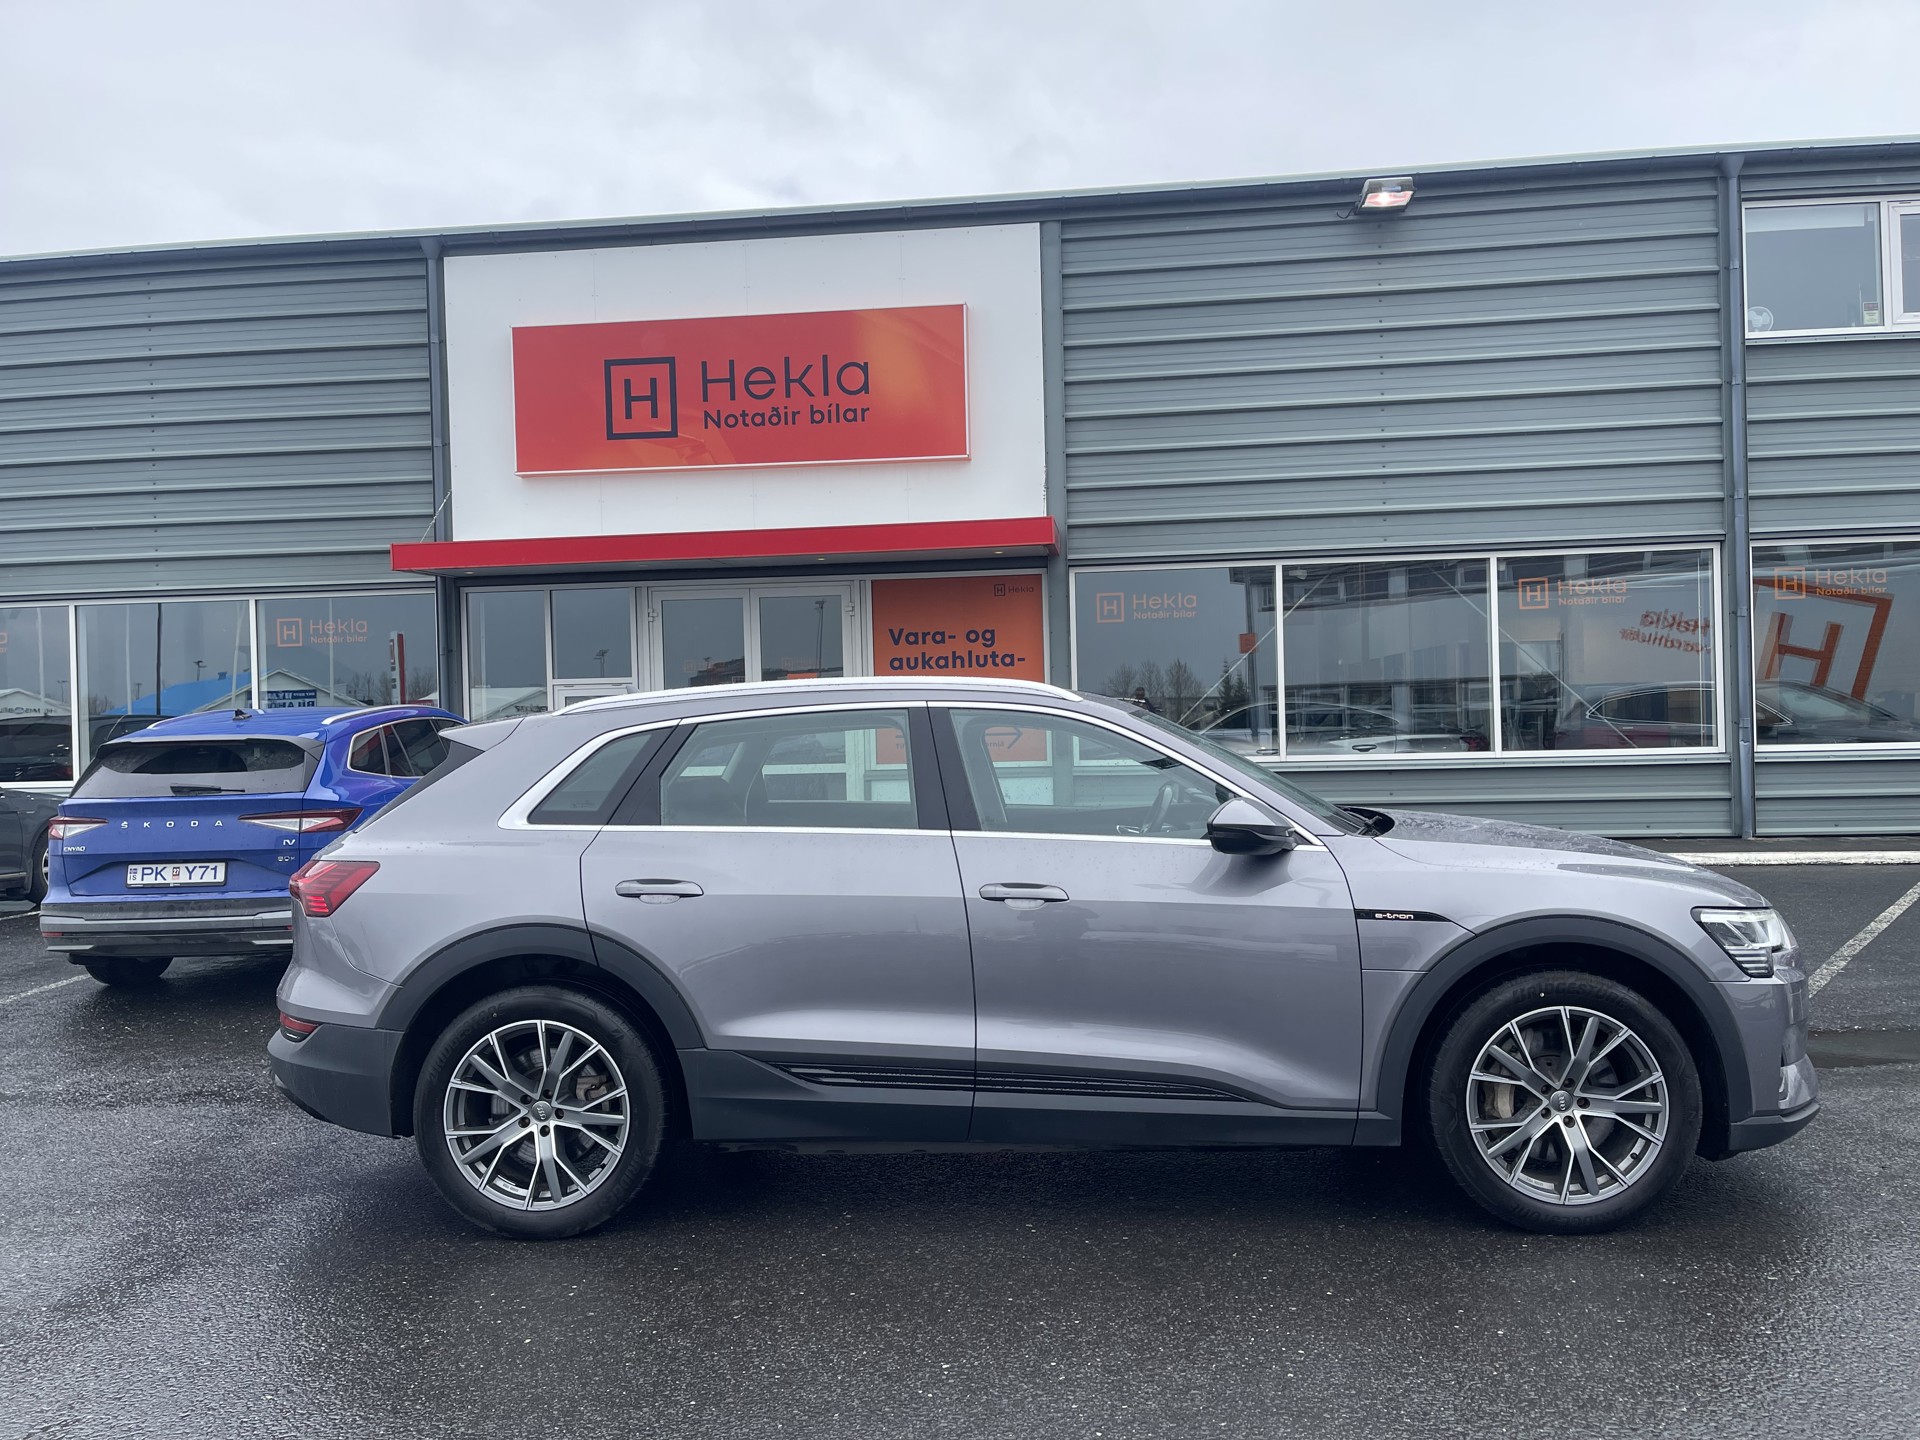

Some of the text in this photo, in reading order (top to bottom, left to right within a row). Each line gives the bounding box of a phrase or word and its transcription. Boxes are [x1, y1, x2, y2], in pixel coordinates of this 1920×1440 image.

[701, 354, 870, 402] Hekla
[704, 403, 870, 429] Notaðir bílar
[1816, 568, 1887, 586] Hekla
[1008, 585, 1034, 593] Hekla
[1133, 592, 1197, 610] Hekla
[309, 618, 368, 634] Hekla
[888, 628, 996, 648] Vara- og
[889, 651, 1026, 671] aukahluta-
[120, 820, 224, 829] ŠKODA
[141, 866, 168, 882] PK
[184, 865, 219, 880] Y71
[1374, 912, 1415, 920] e-tron
